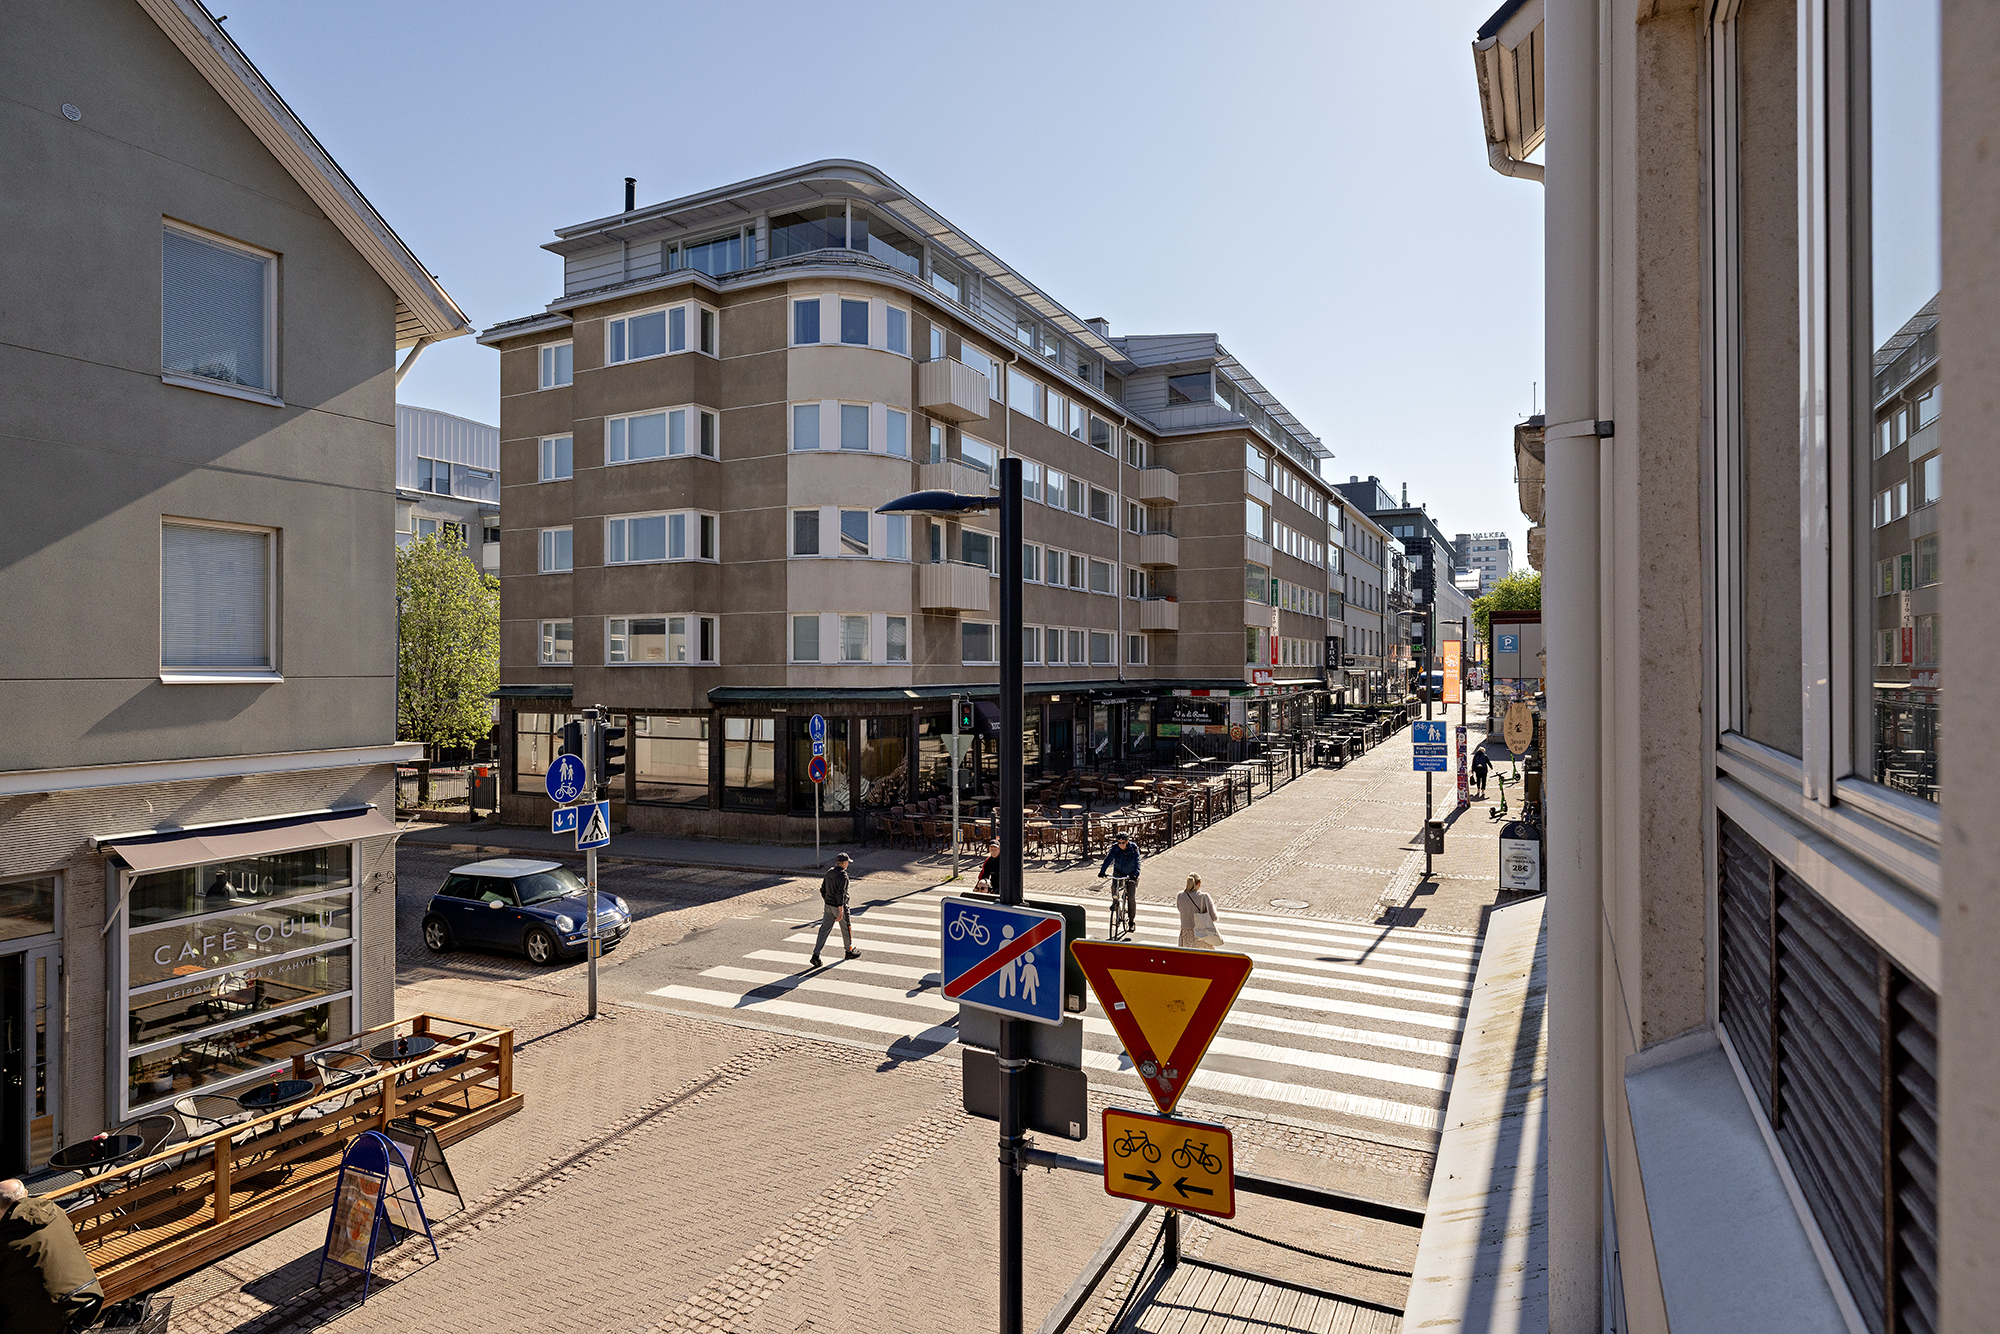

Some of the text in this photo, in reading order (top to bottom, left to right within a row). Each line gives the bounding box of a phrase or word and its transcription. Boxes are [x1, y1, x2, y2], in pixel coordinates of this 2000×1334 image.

[1504, 638, 1512, 646] P
[1512, 864, 1528, 872] 28€
[154, 911, 333, 965] CAFÉ OULU
[267, 968, 274, 976] &
[278, 956, 323, 973] KAHVILA
